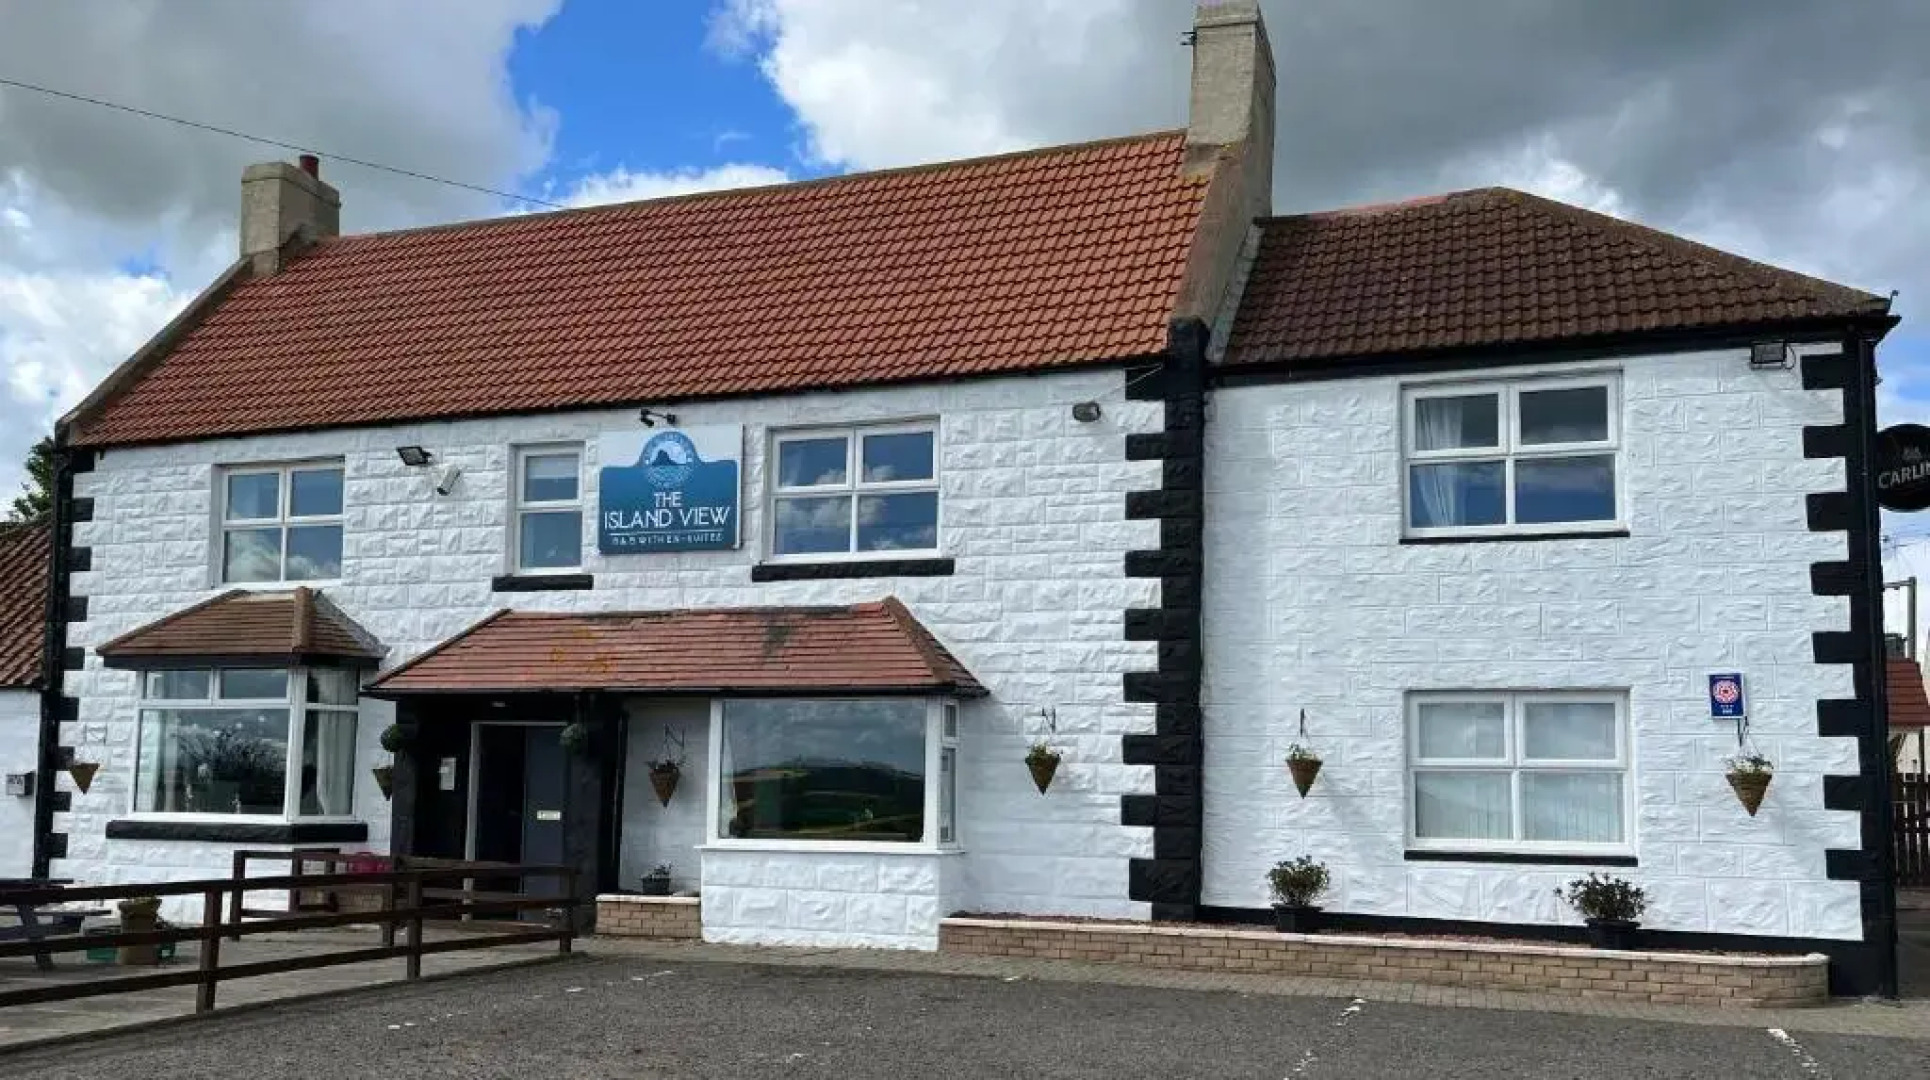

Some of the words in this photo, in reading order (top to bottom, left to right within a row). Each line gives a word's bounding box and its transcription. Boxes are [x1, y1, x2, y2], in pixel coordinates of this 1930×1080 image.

[653, 491, 683, 508] THE
[604, 508, 673, 530] ISLAND
[678, 506, 730, 526] VIEW
